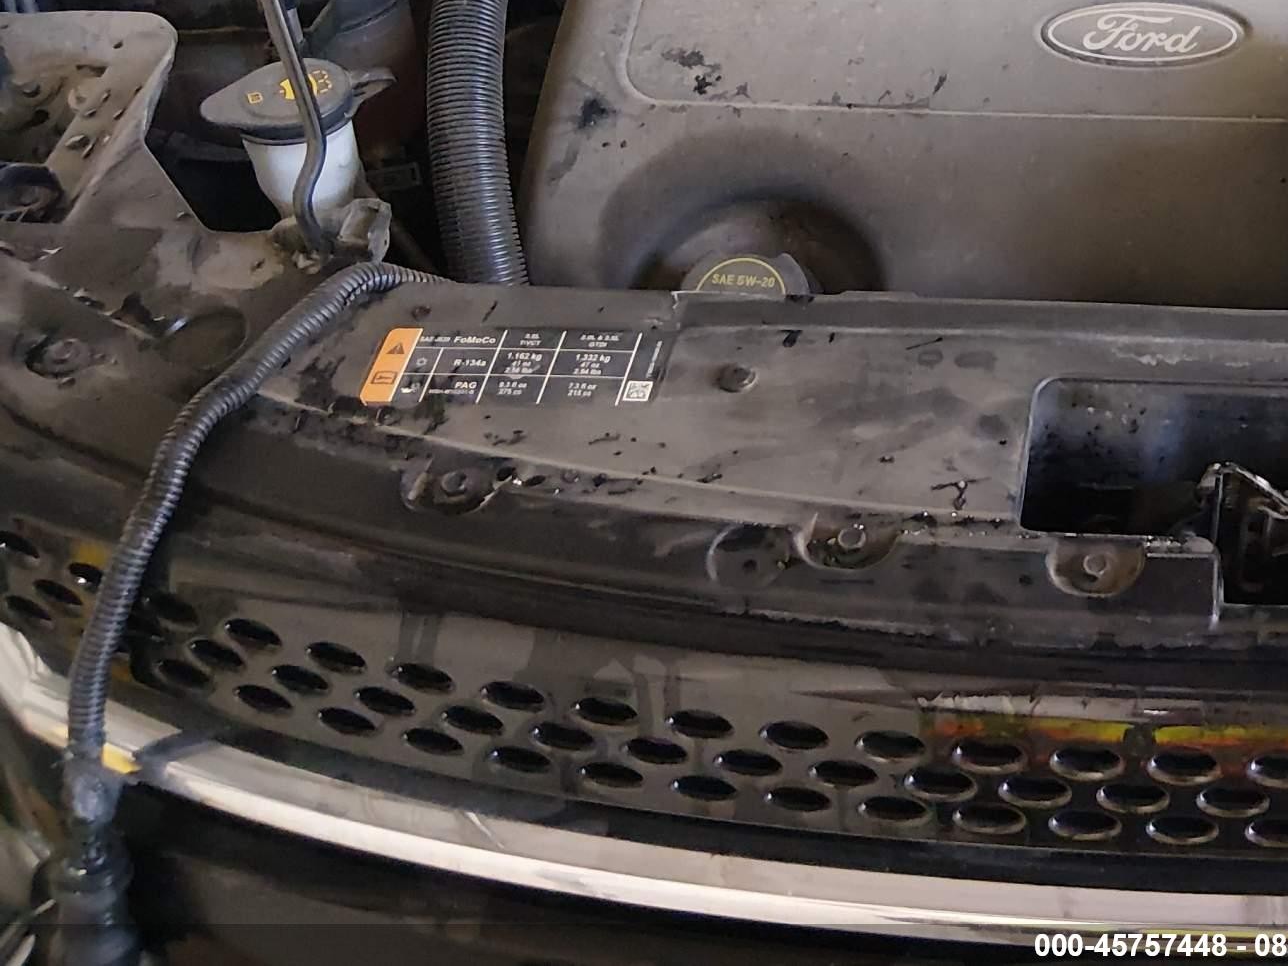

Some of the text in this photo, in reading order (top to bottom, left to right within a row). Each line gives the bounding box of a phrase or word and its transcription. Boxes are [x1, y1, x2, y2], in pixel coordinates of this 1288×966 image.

[1083, 13, 1202, 53] Ford
[712, 274, 775, 288] SAE 5W-20
[454, 336, 496, 344] FoMoCo
[453, 359, 487, 367] R-134a
[455, 381, 477, 389] PAG
